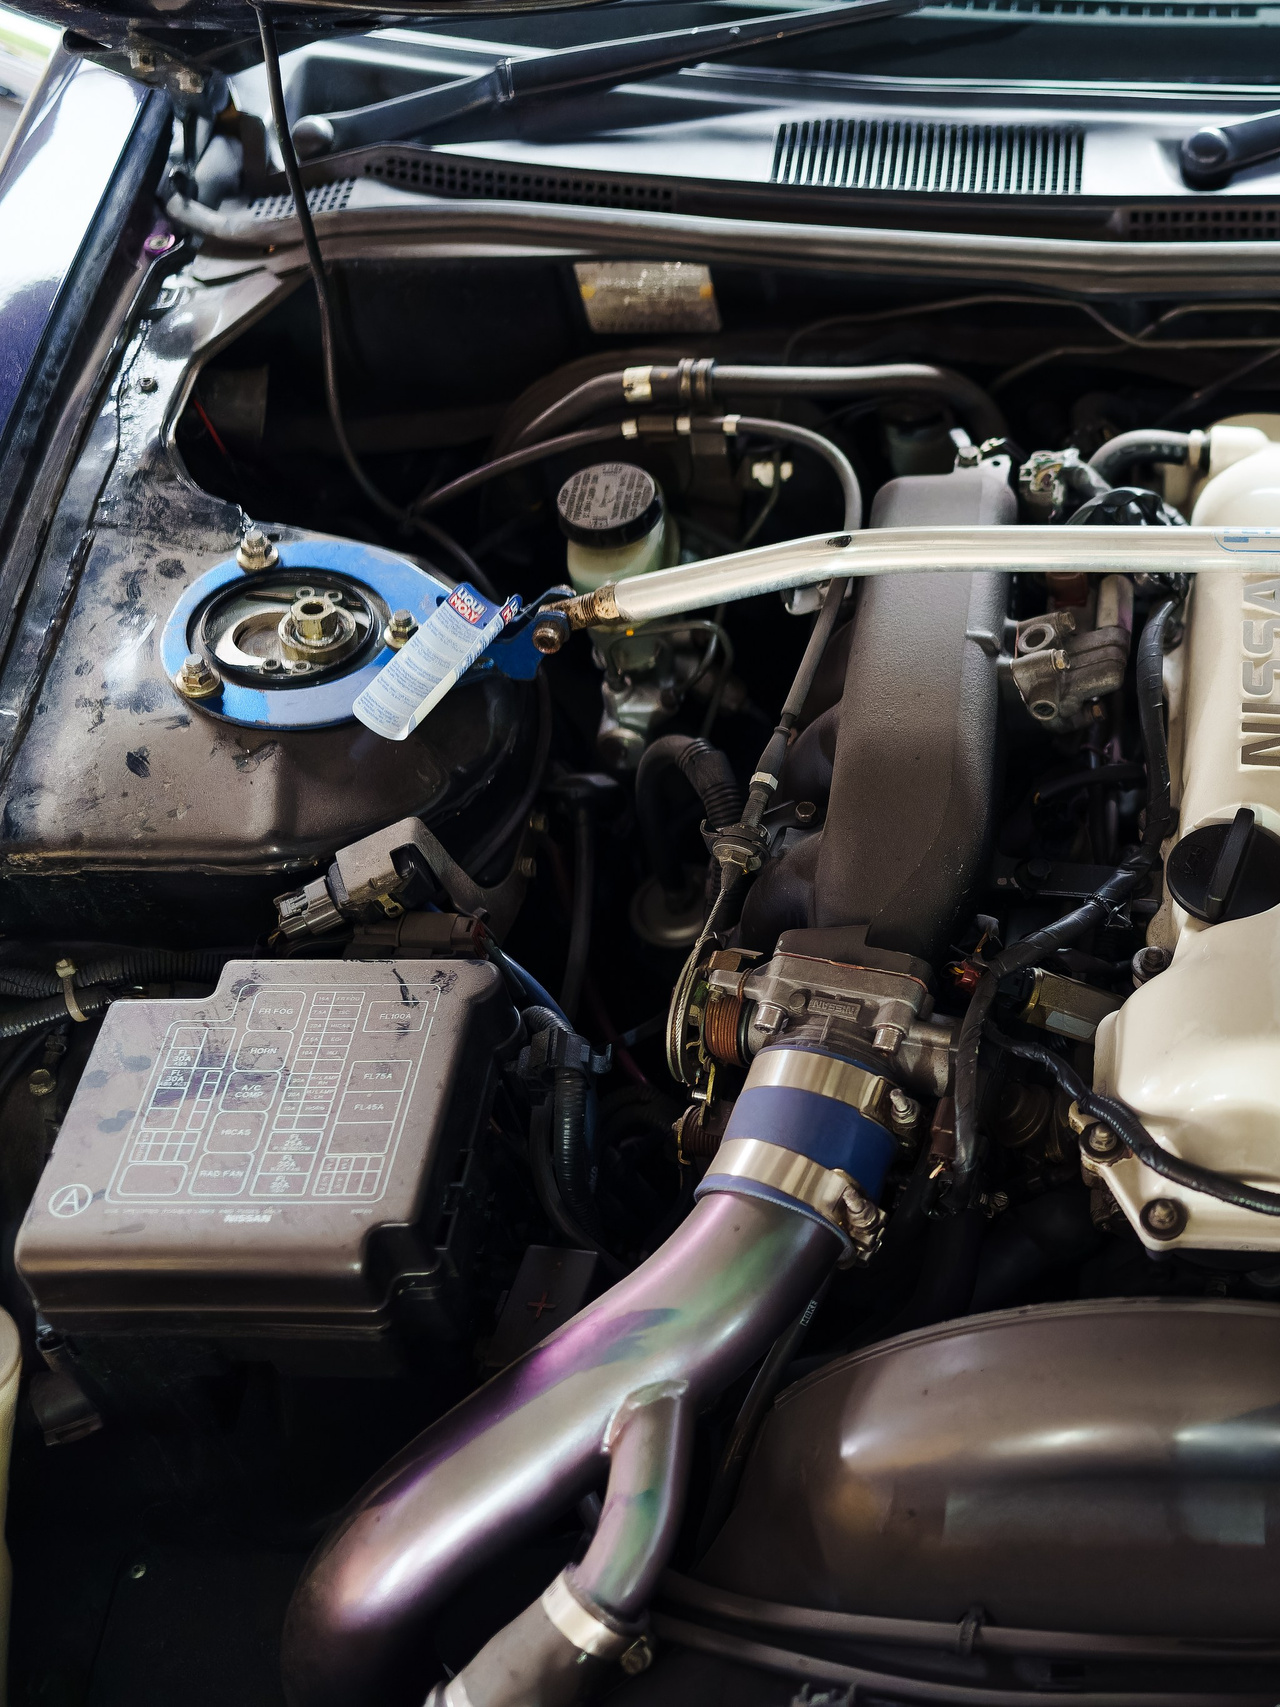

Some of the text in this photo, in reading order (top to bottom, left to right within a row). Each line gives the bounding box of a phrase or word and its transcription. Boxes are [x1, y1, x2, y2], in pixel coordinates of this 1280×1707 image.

[449, 595, 481, 624] MOLY
[456, 586, 487, 615] LIQUI
[222, 1214, 273, 1223] NISSAN
